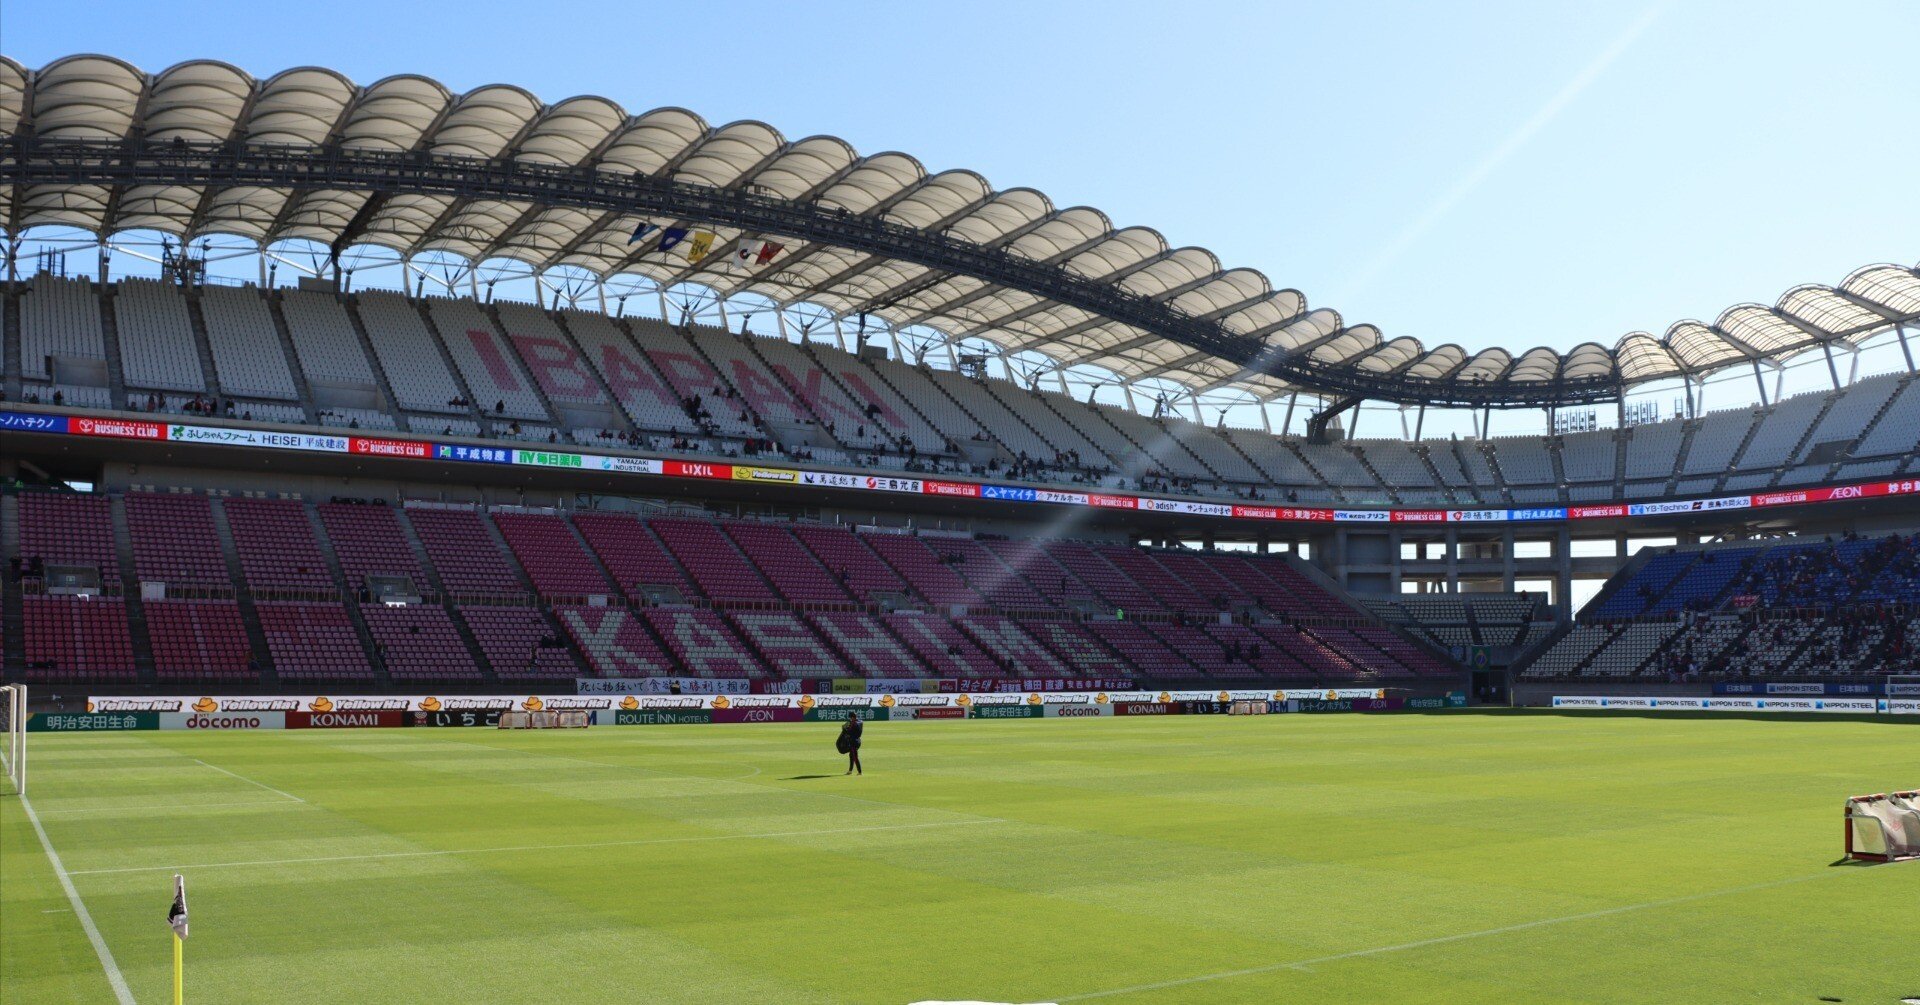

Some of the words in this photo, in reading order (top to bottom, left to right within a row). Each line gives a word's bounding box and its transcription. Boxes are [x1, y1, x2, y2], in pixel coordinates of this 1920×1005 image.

[466, 329, 908, 430] IBARAKI
[95, 424, 135, 436] BUSINESS
[137, 427, 158, 437] CLUB
[187, 429, 256, 442] ふしちゃんファーム
[262, 435, 301, 446] HEISEI
[306, 437, 346, 449] 平成建設
[370, 444, 404, 454] BUSINESS
[406, 446, 424, 456] CLUB
[457, 447, 505, 461] 平成物産
[537, 453, 582, 467] 毎日薬局
[617, 458, 649, 466] YAMAZAKI
[682, 464, 713, 476] LIXIL
[878, 479, 919, 491] 三島光産
[938, 486, 962, 494] BUSINESS
[963, 487, 975, 496] CLUB
[1000, 488, 1033, 500] ヤマイチ
[1583, 509, 1608, 517] BUSINESS
[1609, 508, 1622, 516] CLUB
[763, 682, 802, 693] UNIDOS
[981, 706, 1032, 717] 明治安田生命
[1058, 706, 1100, 717] docomo
[1127, 704, 1167, 714] KONAMI
[47, 715, 137, 729] 明治安田生命
[186, 714, 260, 728] docomo
[311, 714, 378, 726] KONAMI
[619, 714, 653, 724] ROUTE
[679, 715, 709, 723] HOTELS
